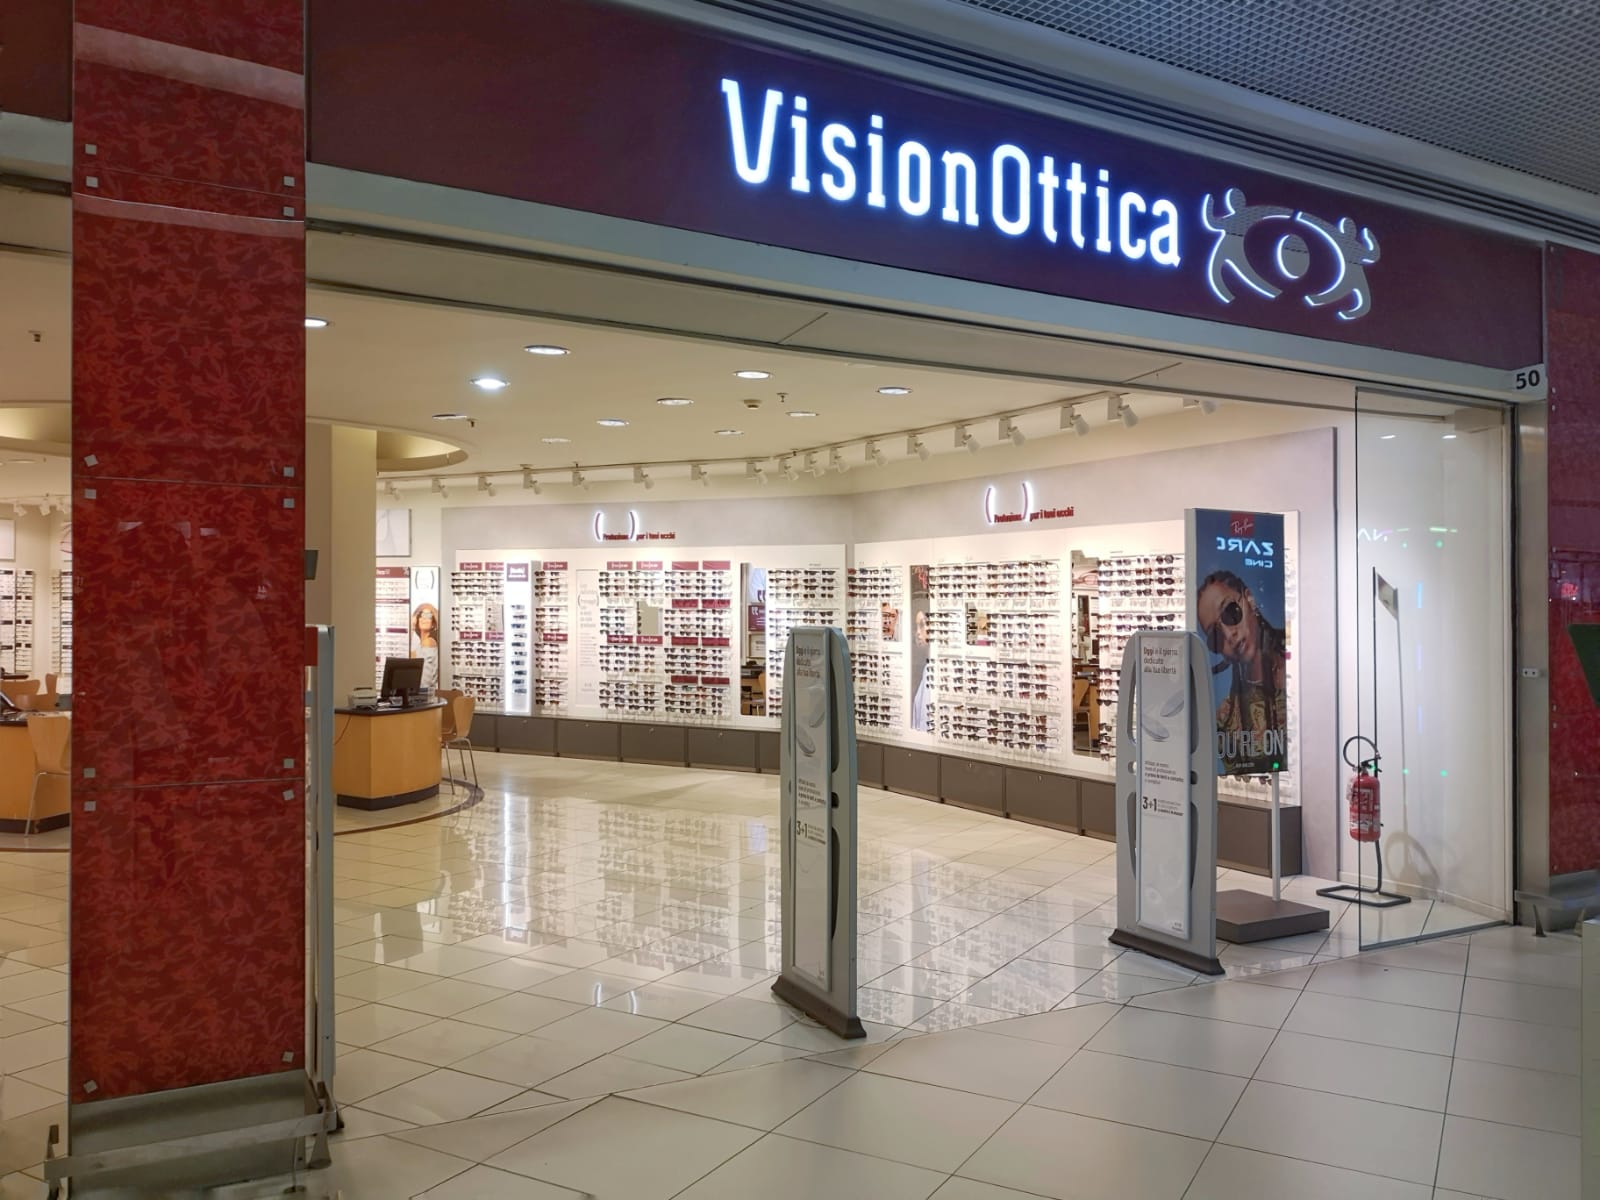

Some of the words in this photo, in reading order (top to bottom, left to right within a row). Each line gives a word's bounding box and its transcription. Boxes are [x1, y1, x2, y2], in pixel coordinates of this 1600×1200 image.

[721, 78, 1181, 268] VisionOttica
[1516, 370, 1540, 390] 50
[1263, 729, 1284, 756] ON
[1142, 796, 1158, 813] 3+1
